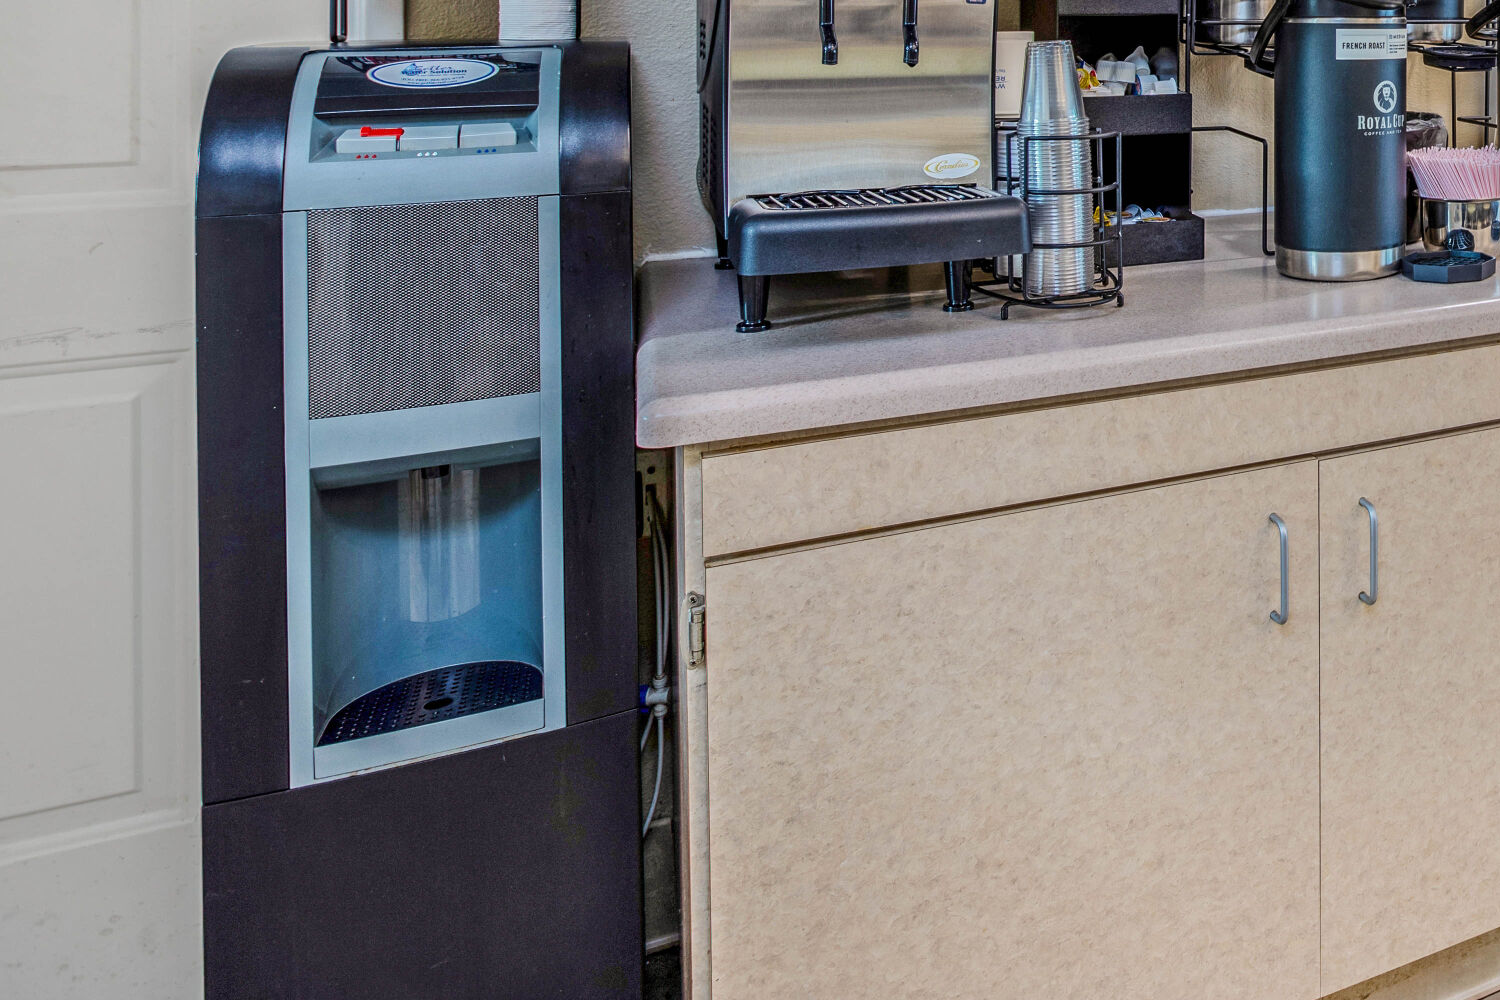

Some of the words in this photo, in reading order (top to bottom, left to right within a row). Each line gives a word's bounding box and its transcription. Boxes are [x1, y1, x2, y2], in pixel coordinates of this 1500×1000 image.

[1342, 41, 1367, 50] FRENCH
[1368, 41, 1385, 50] ROAST
[1357, 115, 1392, 130] ROYAL
[1392, 113, 1405, 128] CUP
